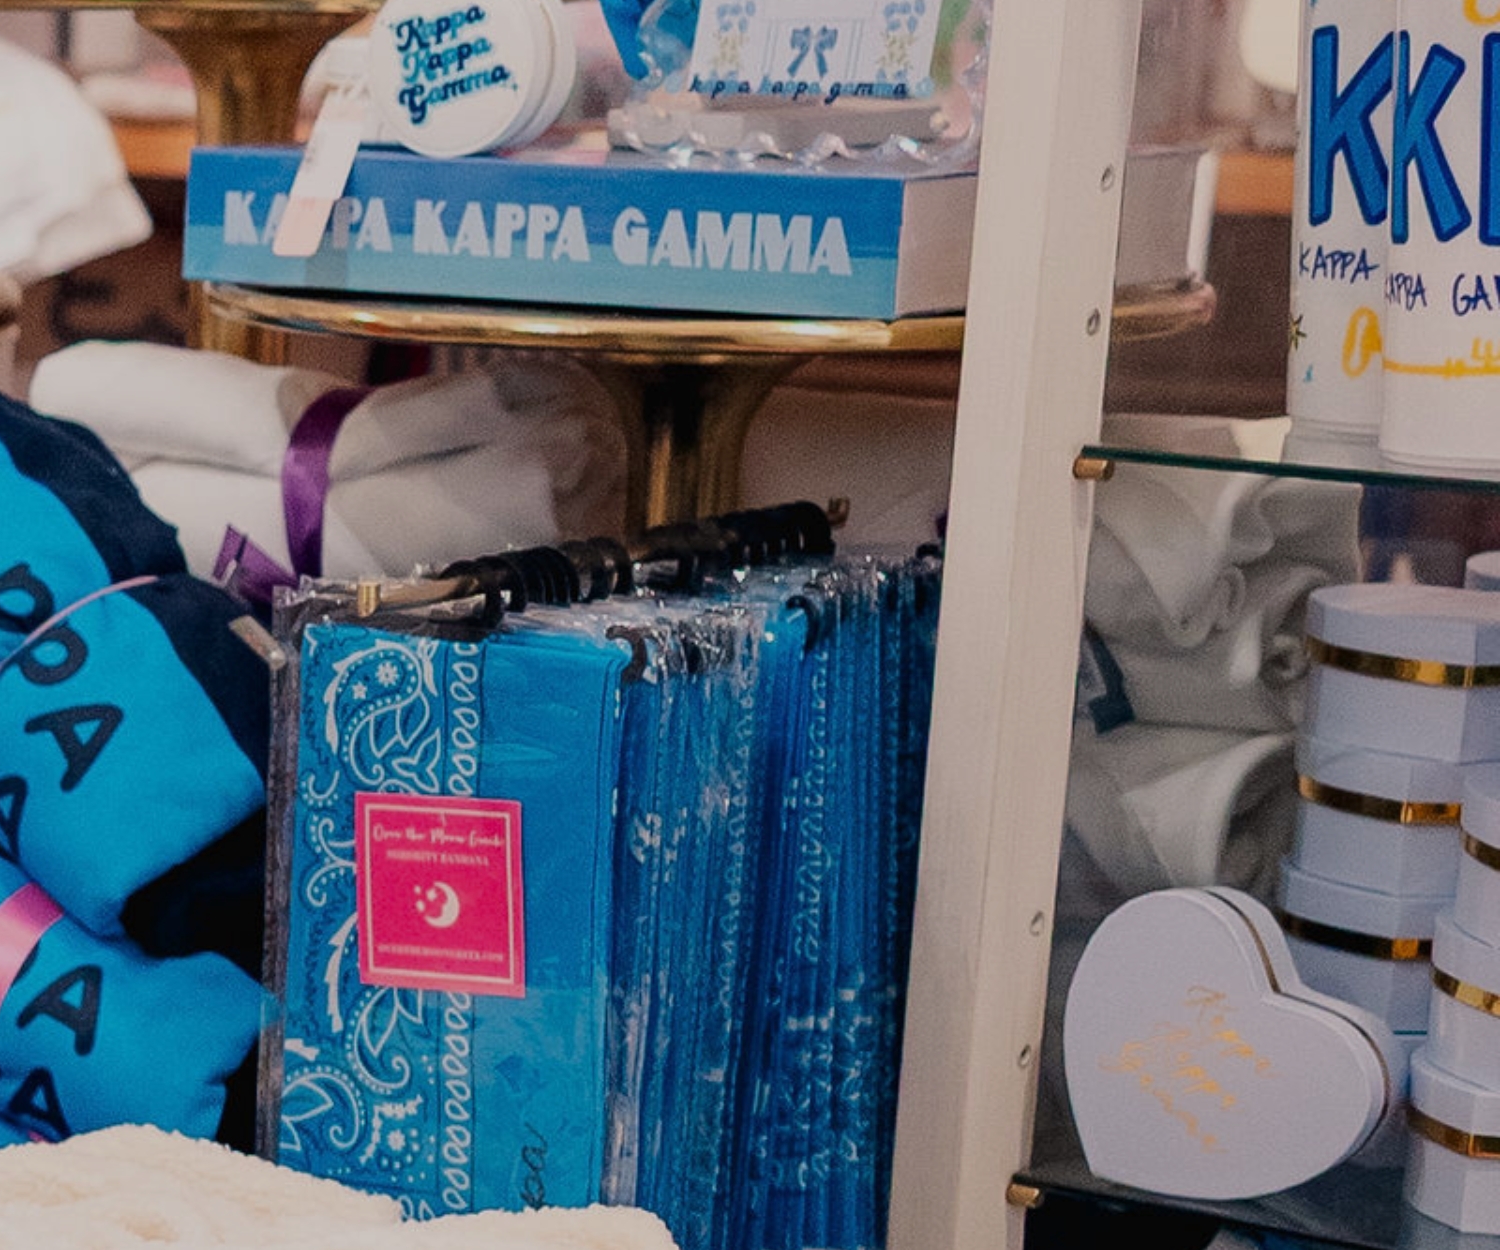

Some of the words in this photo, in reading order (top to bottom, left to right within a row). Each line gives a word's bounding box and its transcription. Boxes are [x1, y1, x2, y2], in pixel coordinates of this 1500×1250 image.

[396, 5, 486, 51] Kappa
[402, 38, 493, 83] Kappa
[398, 65, 510, 124] Gamma
[222, 189, 394, 254] KAPA
[412, 199, 592, 266] KAPPA
[611, 208, 854, 278] GAMMA
[1299, 242, 1380, 284] KAPPA
[1384, 273, 1428, 311] APPA
